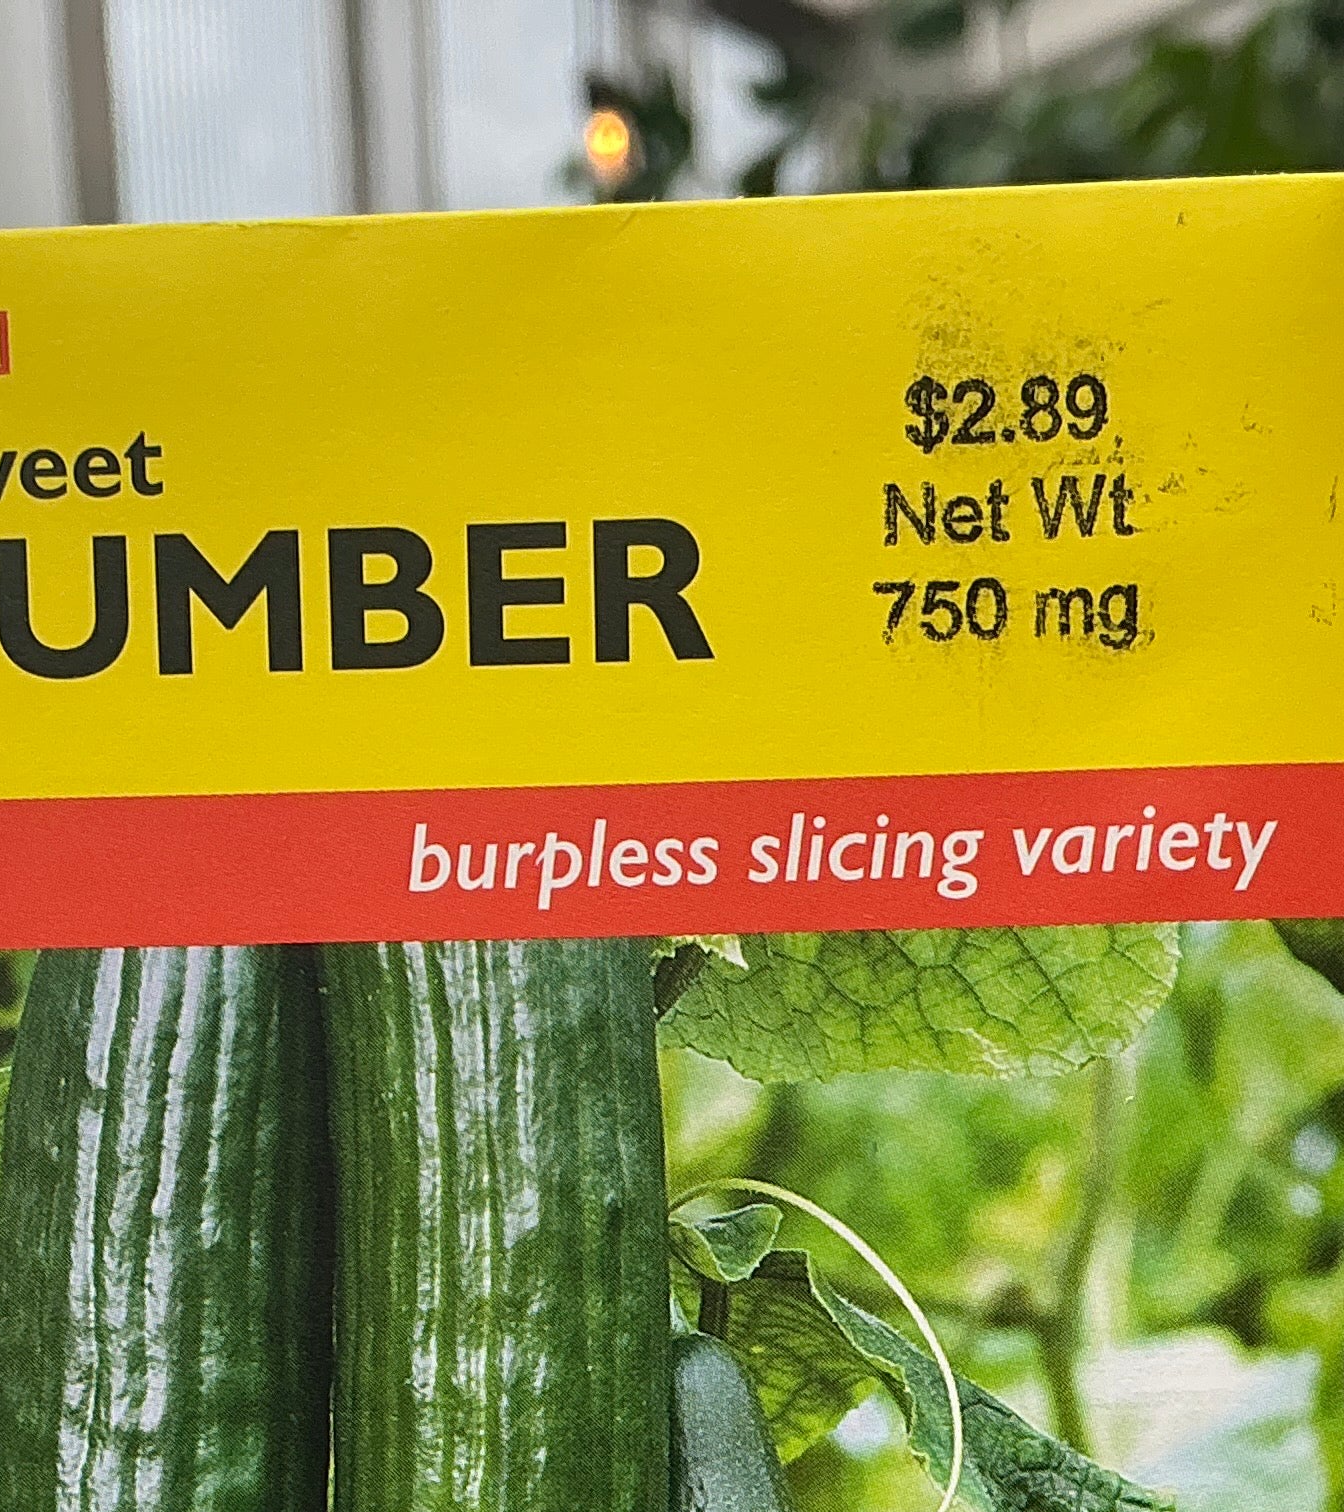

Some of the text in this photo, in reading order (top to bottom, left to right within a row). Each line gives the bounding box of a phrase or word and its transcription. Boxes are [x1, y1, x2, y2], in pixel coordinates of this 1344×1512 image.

[903, 373, 1109, 451] $2.89
[883, 474, 1135, 546] Net Wt
[872, 578, 1142, 651] 750 mg
[408, 805, 1278, 910] burpless slicing variety
